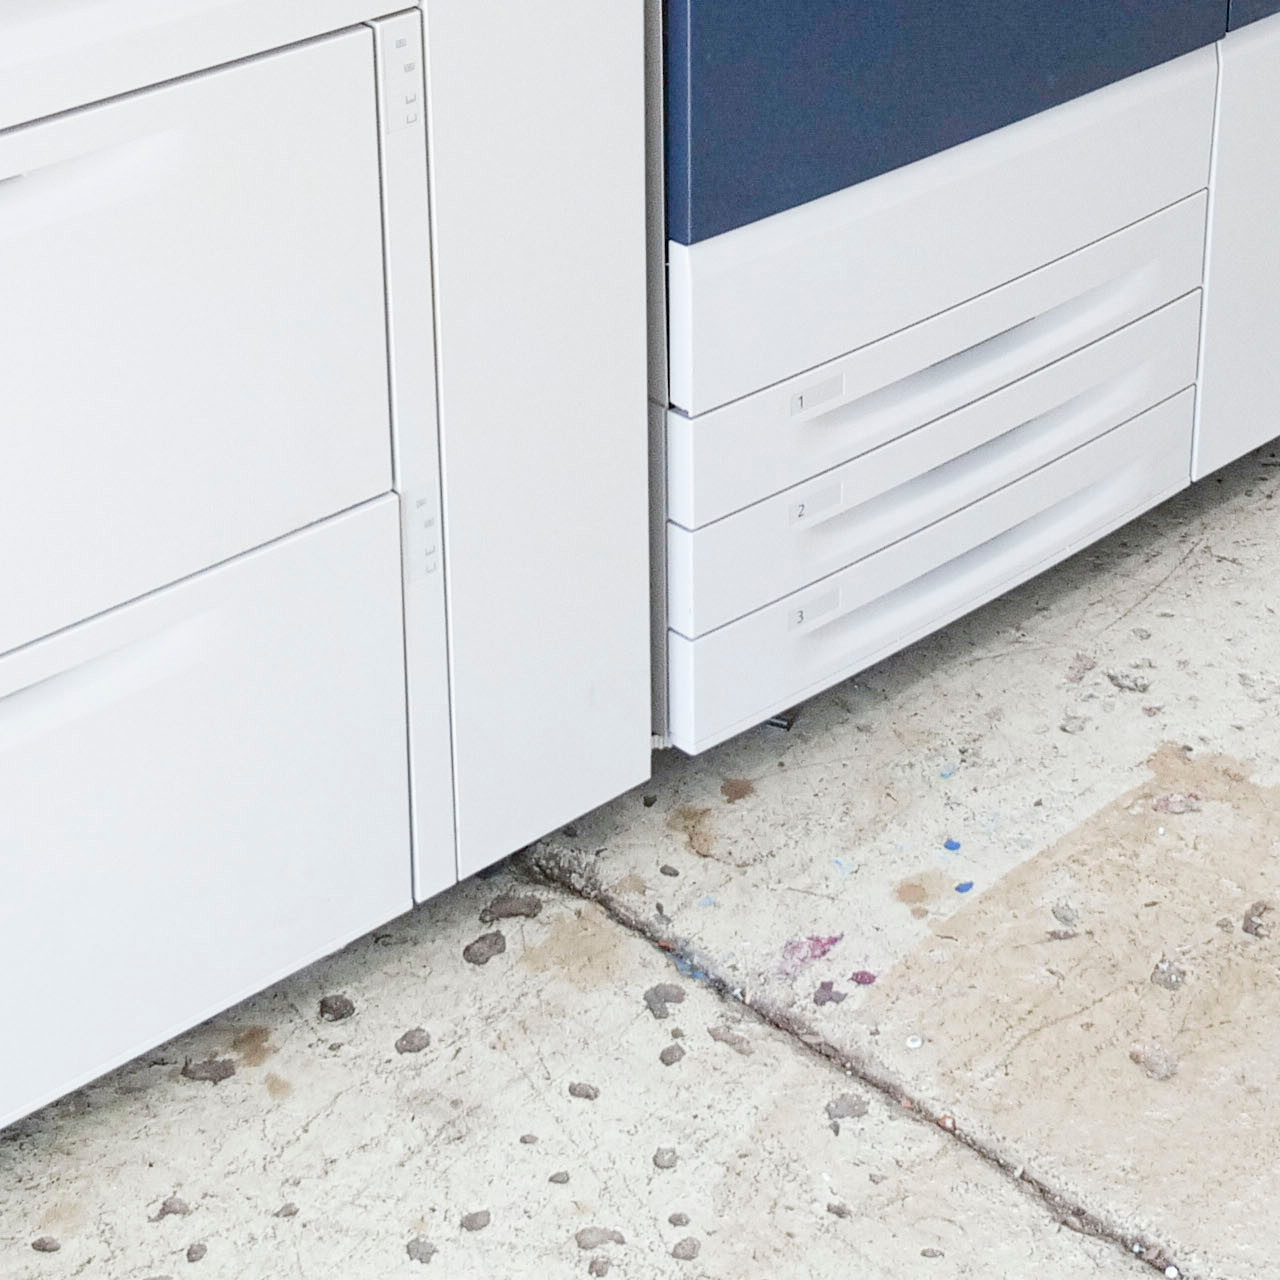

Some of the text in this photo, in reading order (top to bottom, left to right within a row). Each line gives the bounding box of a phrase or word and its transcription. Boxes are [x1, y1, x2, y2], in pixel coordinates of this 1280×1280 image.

[798, 395, 804, 409] 1
[798, 503, 805, 518] 2
[797, 609, 805, 624] 3
